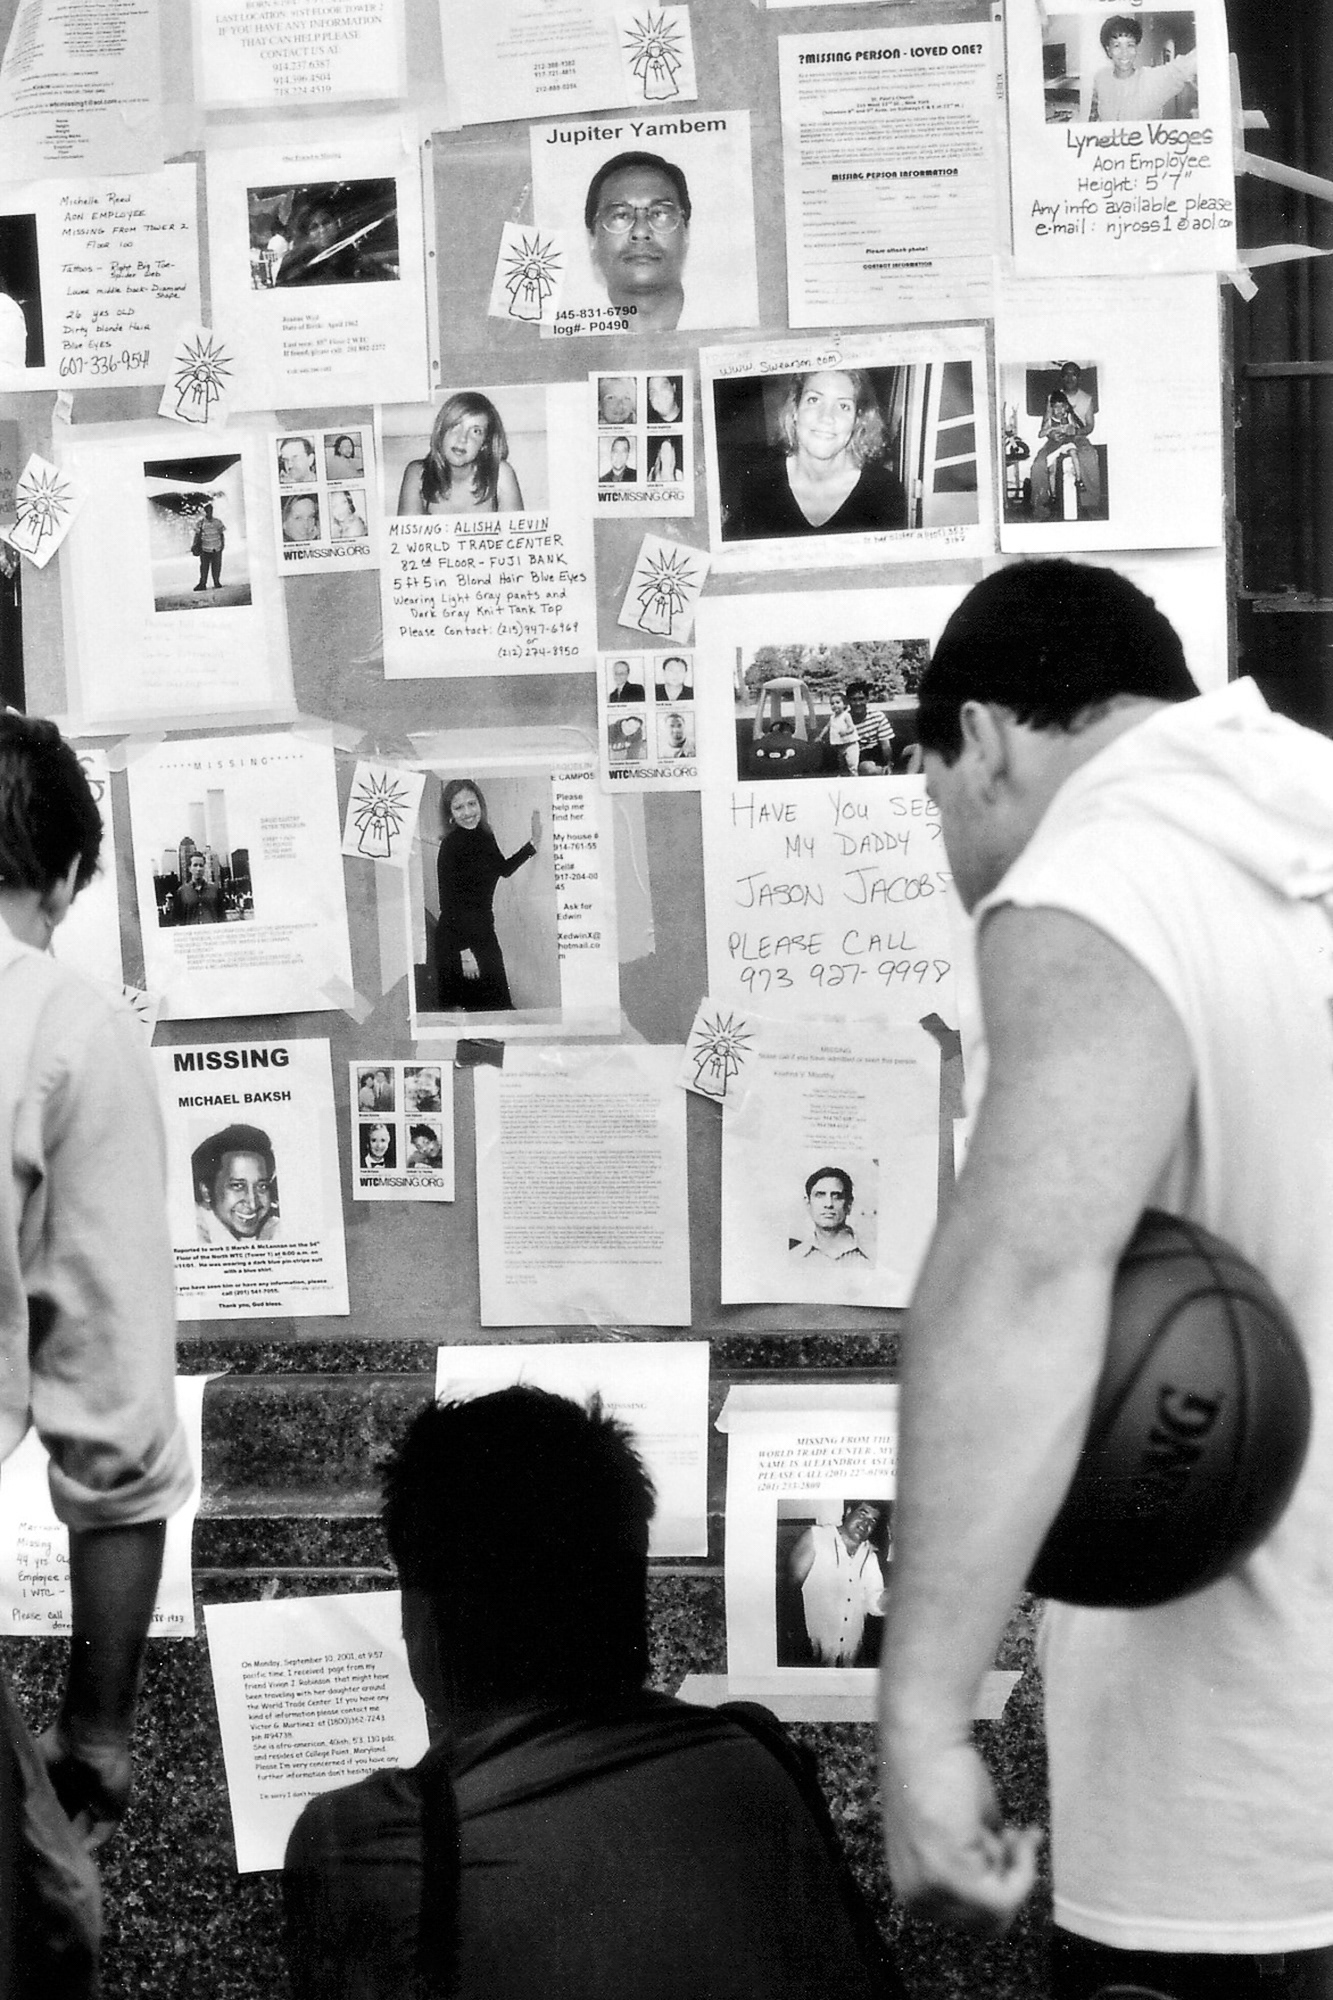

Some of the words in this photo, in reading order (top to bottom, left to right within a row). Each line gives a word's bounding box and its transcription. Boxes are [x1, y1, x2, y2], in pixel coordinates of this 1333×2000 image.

[230, 24, 251, 35] YOU
[255, 22, 281, 33] HAVE
[310, 15, 382, 29] INFORMATION
[240, 37, 266, 48] THAT
[268, 35, 293, 45] CAN
[294, 32, 321, 43] HELP
[322, 30, 360, 41] PLEASE
[259, 46, 308, 59] CONTACT
[855, 48, 901, 62] PERSON
[911, 45, 948, 58] LOVED
[951, 43, 983, 55] ONE?
[546, 125, 623, 146] Jupiter
[630, 118, 727, 138] Yambem
[1067, 127, 1143, 158] Lynette
[1147, 122, 1214, 155] Vosges
[1092, 155, 1125, 172] Aon
[1130, 151, 1212, 177] Employee
[831, 172, 864, 182] MISSING
[1031, 199, 1060, 222] Any
[1064, 198, 1098, 215] info
[1105, 197, 1179, 215] available
[1186, 192, 1234, 219] please
[589, 319, 629, 332] P0490
[454, 520, 501, 536] ALISHA
[509, 516, 549, 533] LEVIN
[390, 542, 400, 555] 2
[406, 540, 450, 554] WORLD
[457, 538, 503, 552] TRADE
[506, 533, 564, 550] CENTER
[490, 555, 522, 568] FUJI
[529, 552, 569, 566] BANK
[456, 572, 492, 587] Blond
[499, 571, 525, 585] Hair
[530, 571, 555, 583] Blue
[559, 570, 587, 585] Eyes
[393, 594, 435, 609] Wearing
[441, 592, 470, 608] Light
[475, 590, 501, 606] Gray
[506, 590, 541, 602] pants
[545, 587, 567, 599] and
[410, 607, 437, 619] Dark
[442, 607, 470, 623] Gray
[508, 603, 536, 615] Tank
[540, 602, 563, 616] Top
[399, 625, 436, 638] Please
[526, 636, 539, 645] or
[730, 791, 798, 829] HAVE
[785, 833, 814, 859] MY
[832, 829, 910, 856] DADDY
[734, 870, 824, 908] JASON
[728, 930, 825, 961] PLEASE
[842, 929, 918, 956] CALL
[739, 965, 795, 993] 973
[173, 1047, 290, 1073] MISSING
[178, 1093, 240, 1108] MICHAEL
[243, 1090, 292, 1104] BAKSH
[12, 1607, 42, 1621] Please
[241, 1661, 252, 1669] On
[283, 1656, 322, 1667] September
[260, 1701, 283, 1710] World
[285, 1700, 306, 1709] Trade
